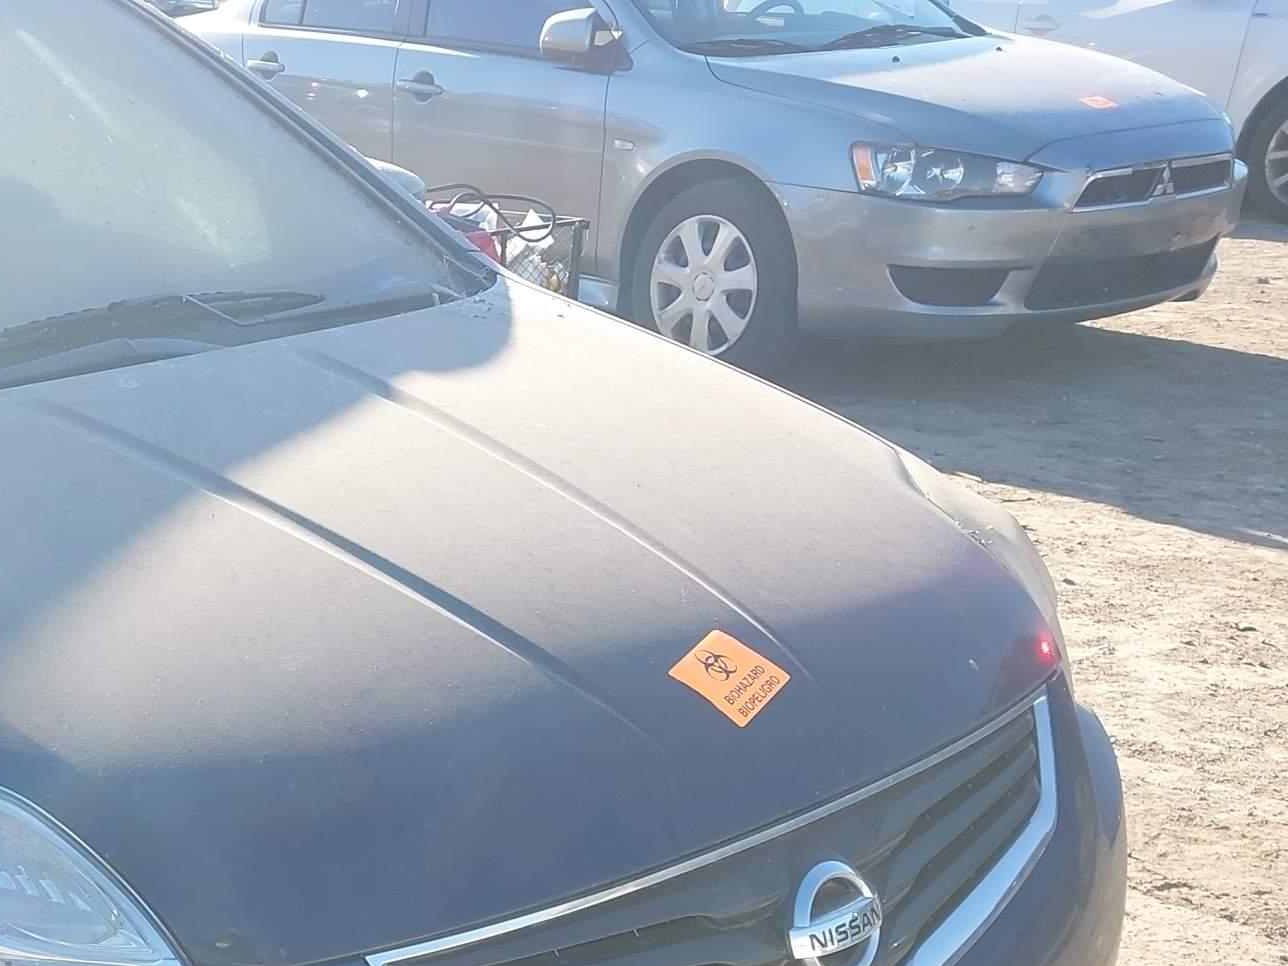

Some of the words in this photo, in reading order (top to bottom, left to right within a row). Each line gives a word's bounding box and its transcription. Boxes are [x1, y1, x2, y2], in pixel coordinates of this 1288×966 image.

[724, 665, 765, 705] BIOHAZARD
[738, 675, 780, 717] BIOPELIGRO
[809, 907, 880, 951] NISSAN
